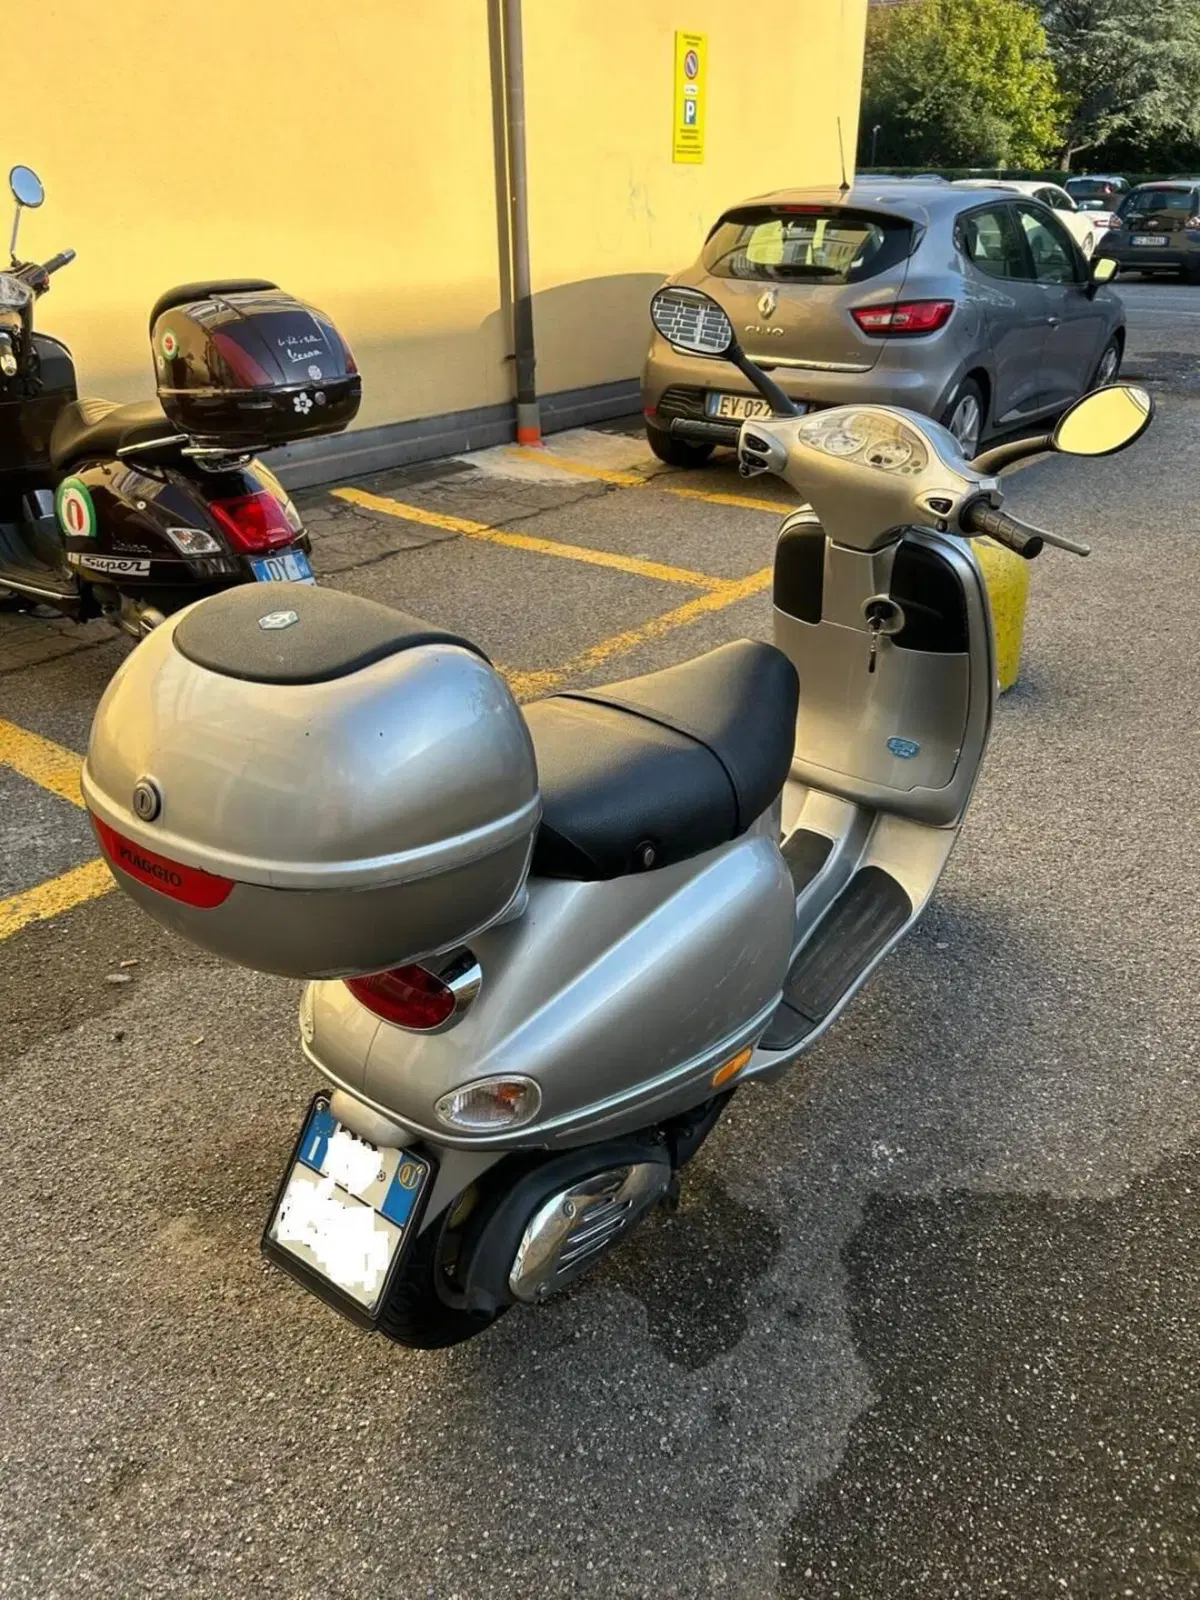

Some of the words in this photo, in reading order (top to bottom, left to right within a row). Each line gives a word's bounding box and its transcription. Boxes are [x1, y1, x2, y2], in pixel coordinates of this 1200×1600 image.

[686, 101, 695, 123] P
[720, 396, 740, 416] EV
[266, 557, 291, 581] DY
[120, 847, 183, 887] PIAGGIO
